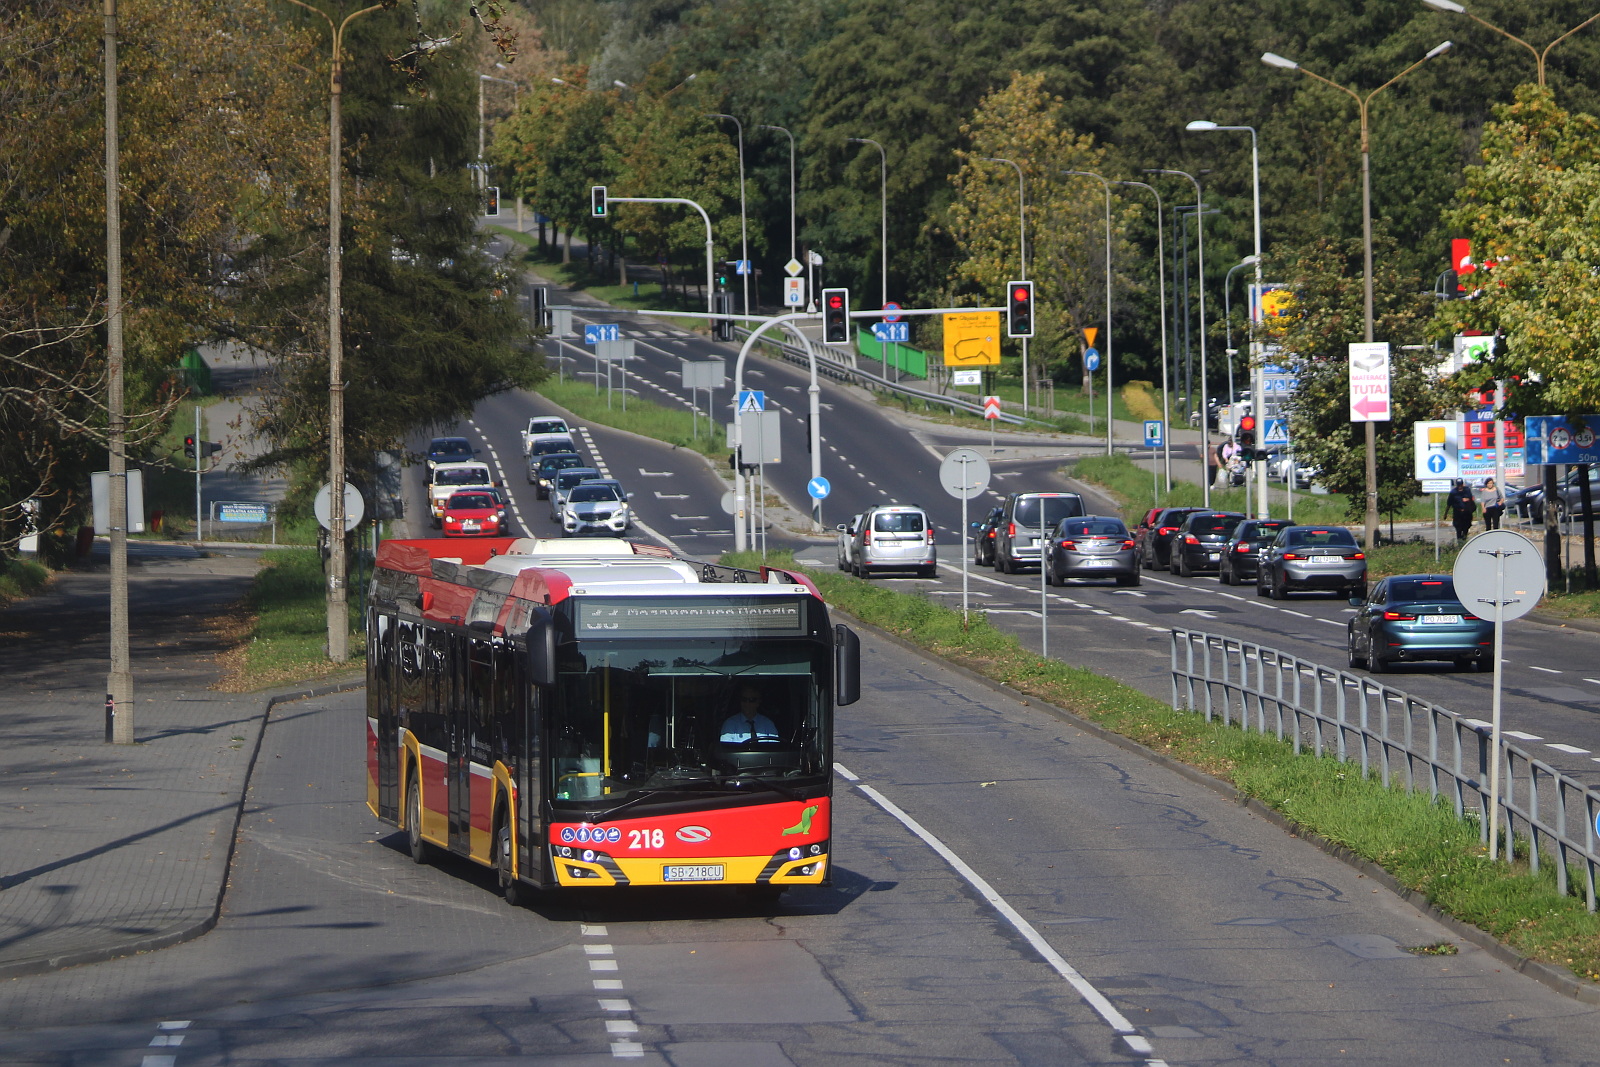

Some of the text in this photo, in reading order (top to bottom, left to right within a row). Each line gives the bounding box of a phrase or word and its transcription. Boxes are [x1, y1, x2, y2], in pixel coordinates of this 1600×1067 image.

[1352, 384, 1388, 394] TUTAJ
[628, 828, 665, 848] 218
[671, 866, 721, 878] SB 218CU
